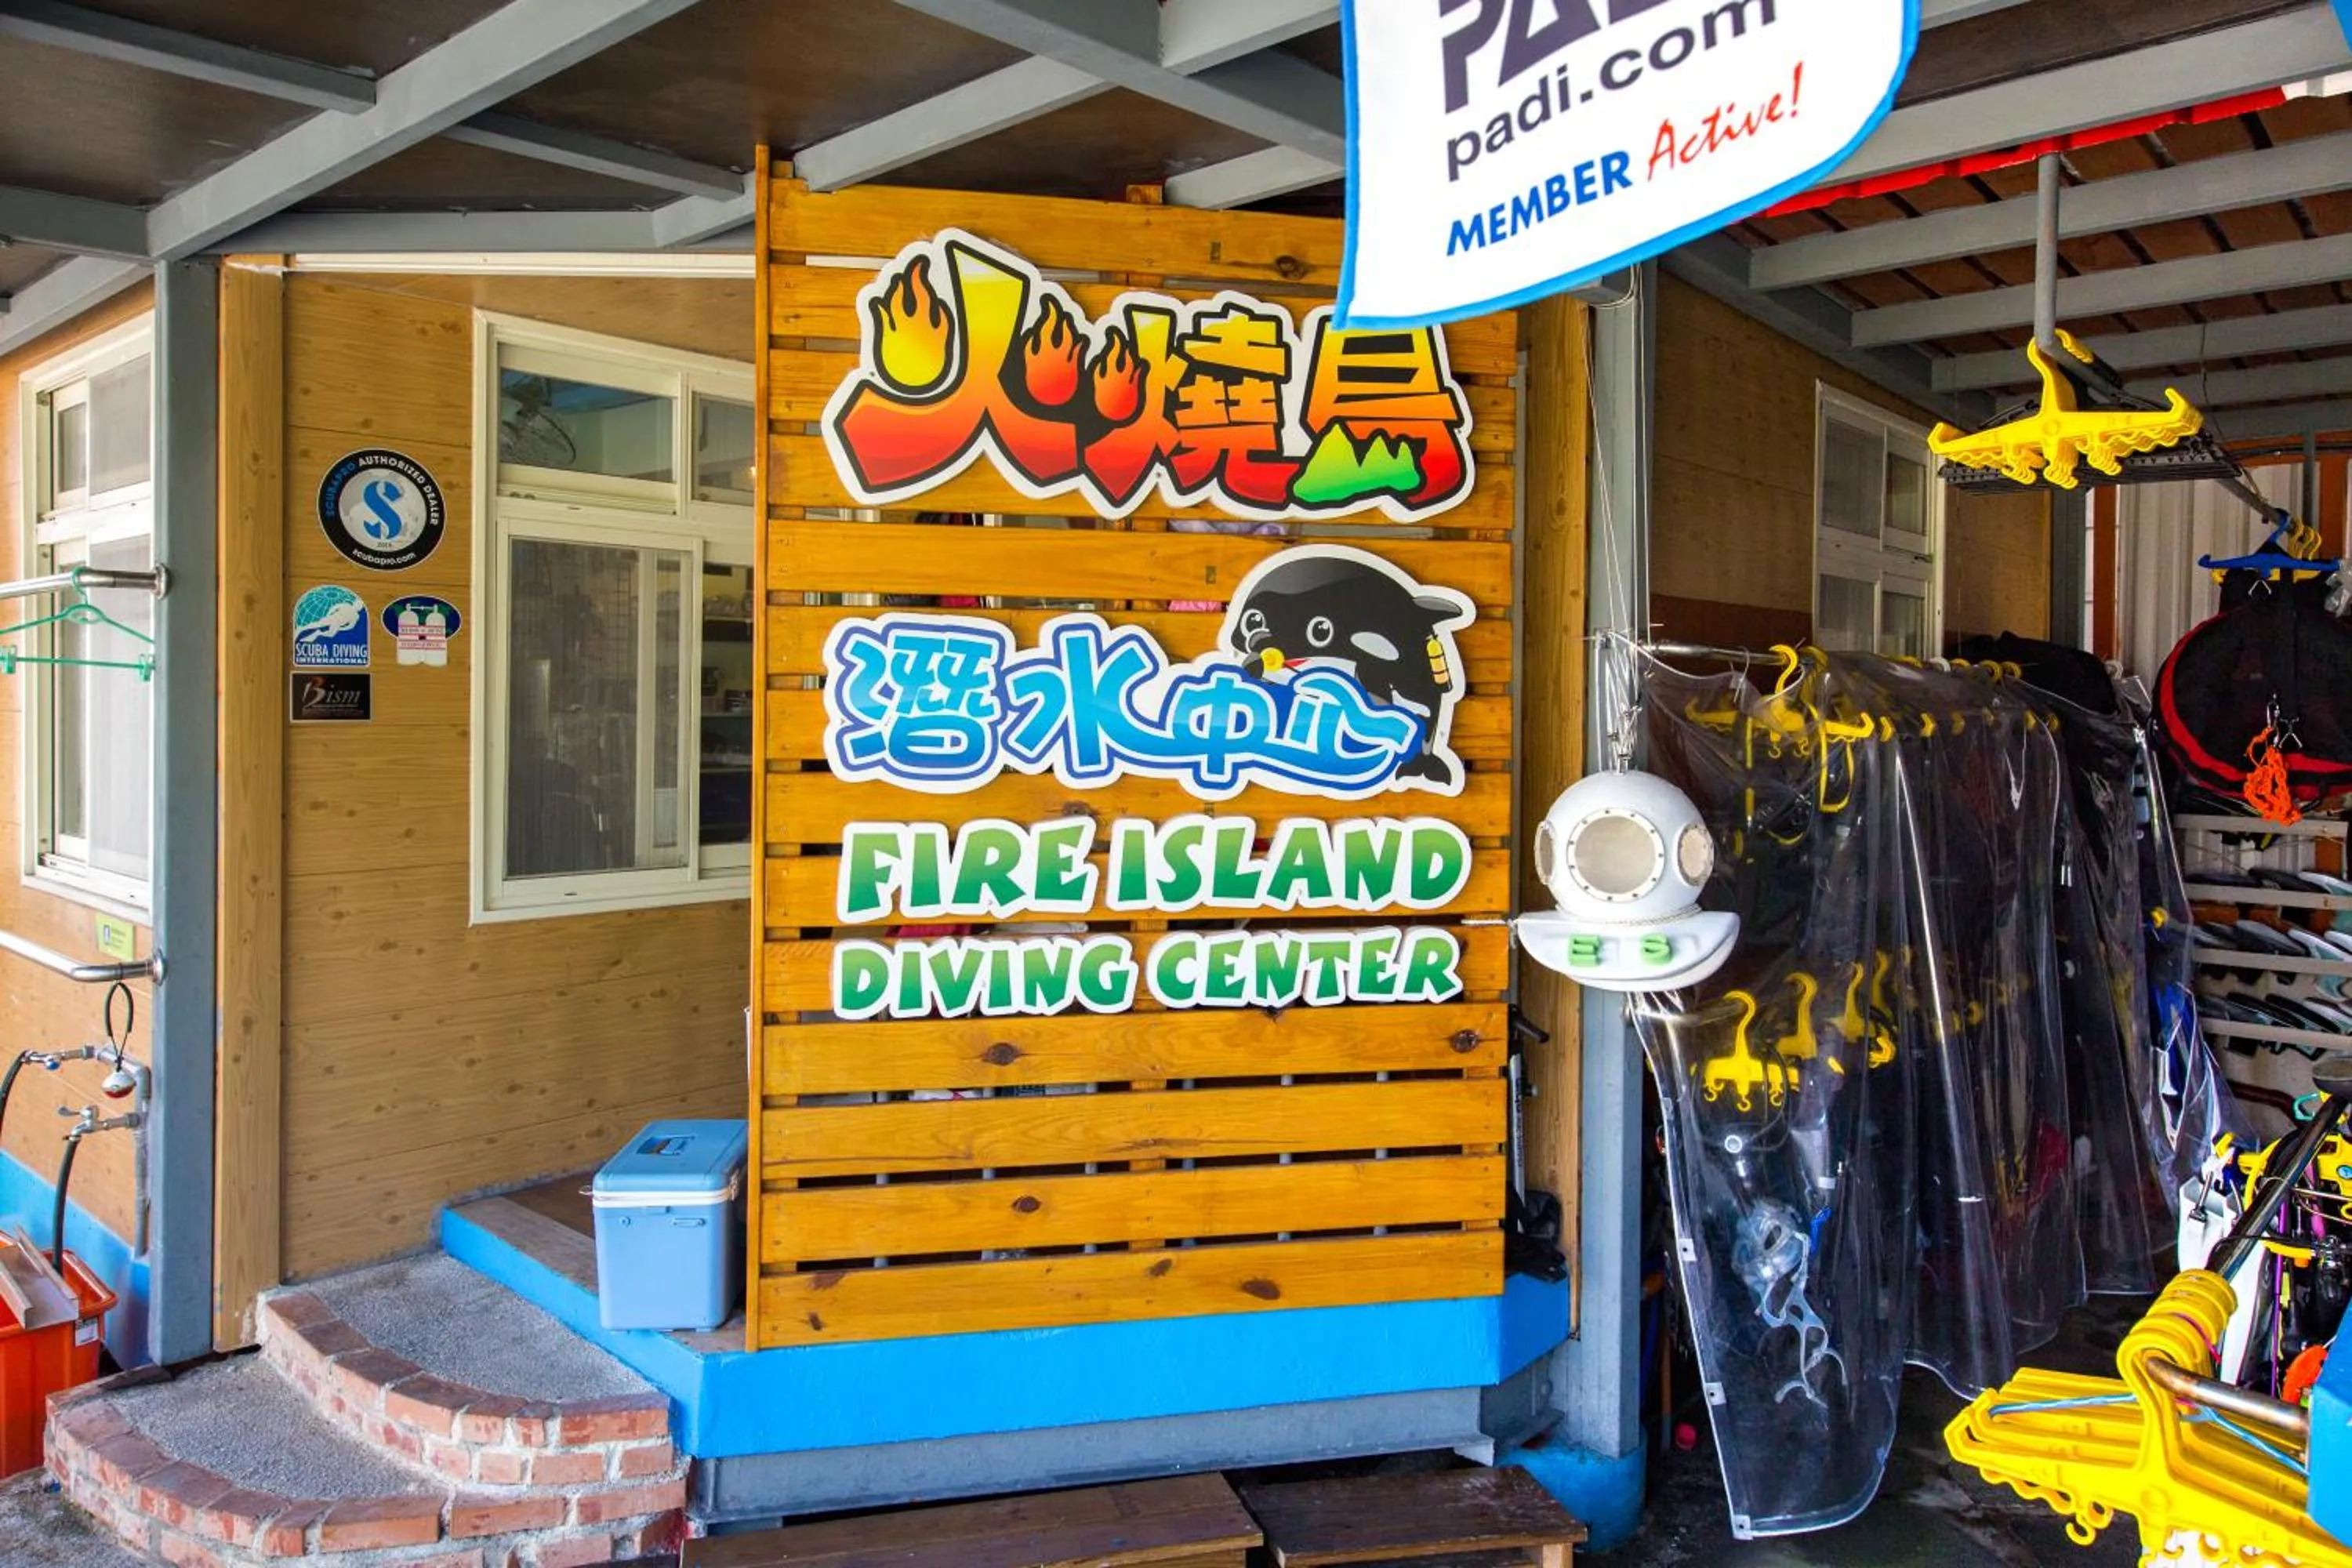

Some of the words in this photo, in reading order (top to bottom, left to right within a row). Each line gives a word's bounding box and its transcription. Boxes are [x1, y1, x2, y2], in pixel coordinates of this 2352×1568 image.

[1446, 0, 1777, 182] padi.com
[1446, 151, 1632, 257] MEMBER
[1646, 60, 1804, 181] Active!
[325, 461, 357, 519] SCUBAPRO
[358, 455, 426, 485] AUTHORIZED
[423, 485, 440, 526] DEALER
[352, 548, 418, 566] scubapro.com
[296, 642, 328, 657] SCUBA
[332, 644, 368, 658] DIVING
[835, 622, 1425, 791] 潛水中心
[845, 825, 1091, 914] FIRE
[1117, 823, 1464, 905] ISLAND
[840, 942, 1131, 1012] DIVING
[1156, 935, 1457, 1002] CENTER
